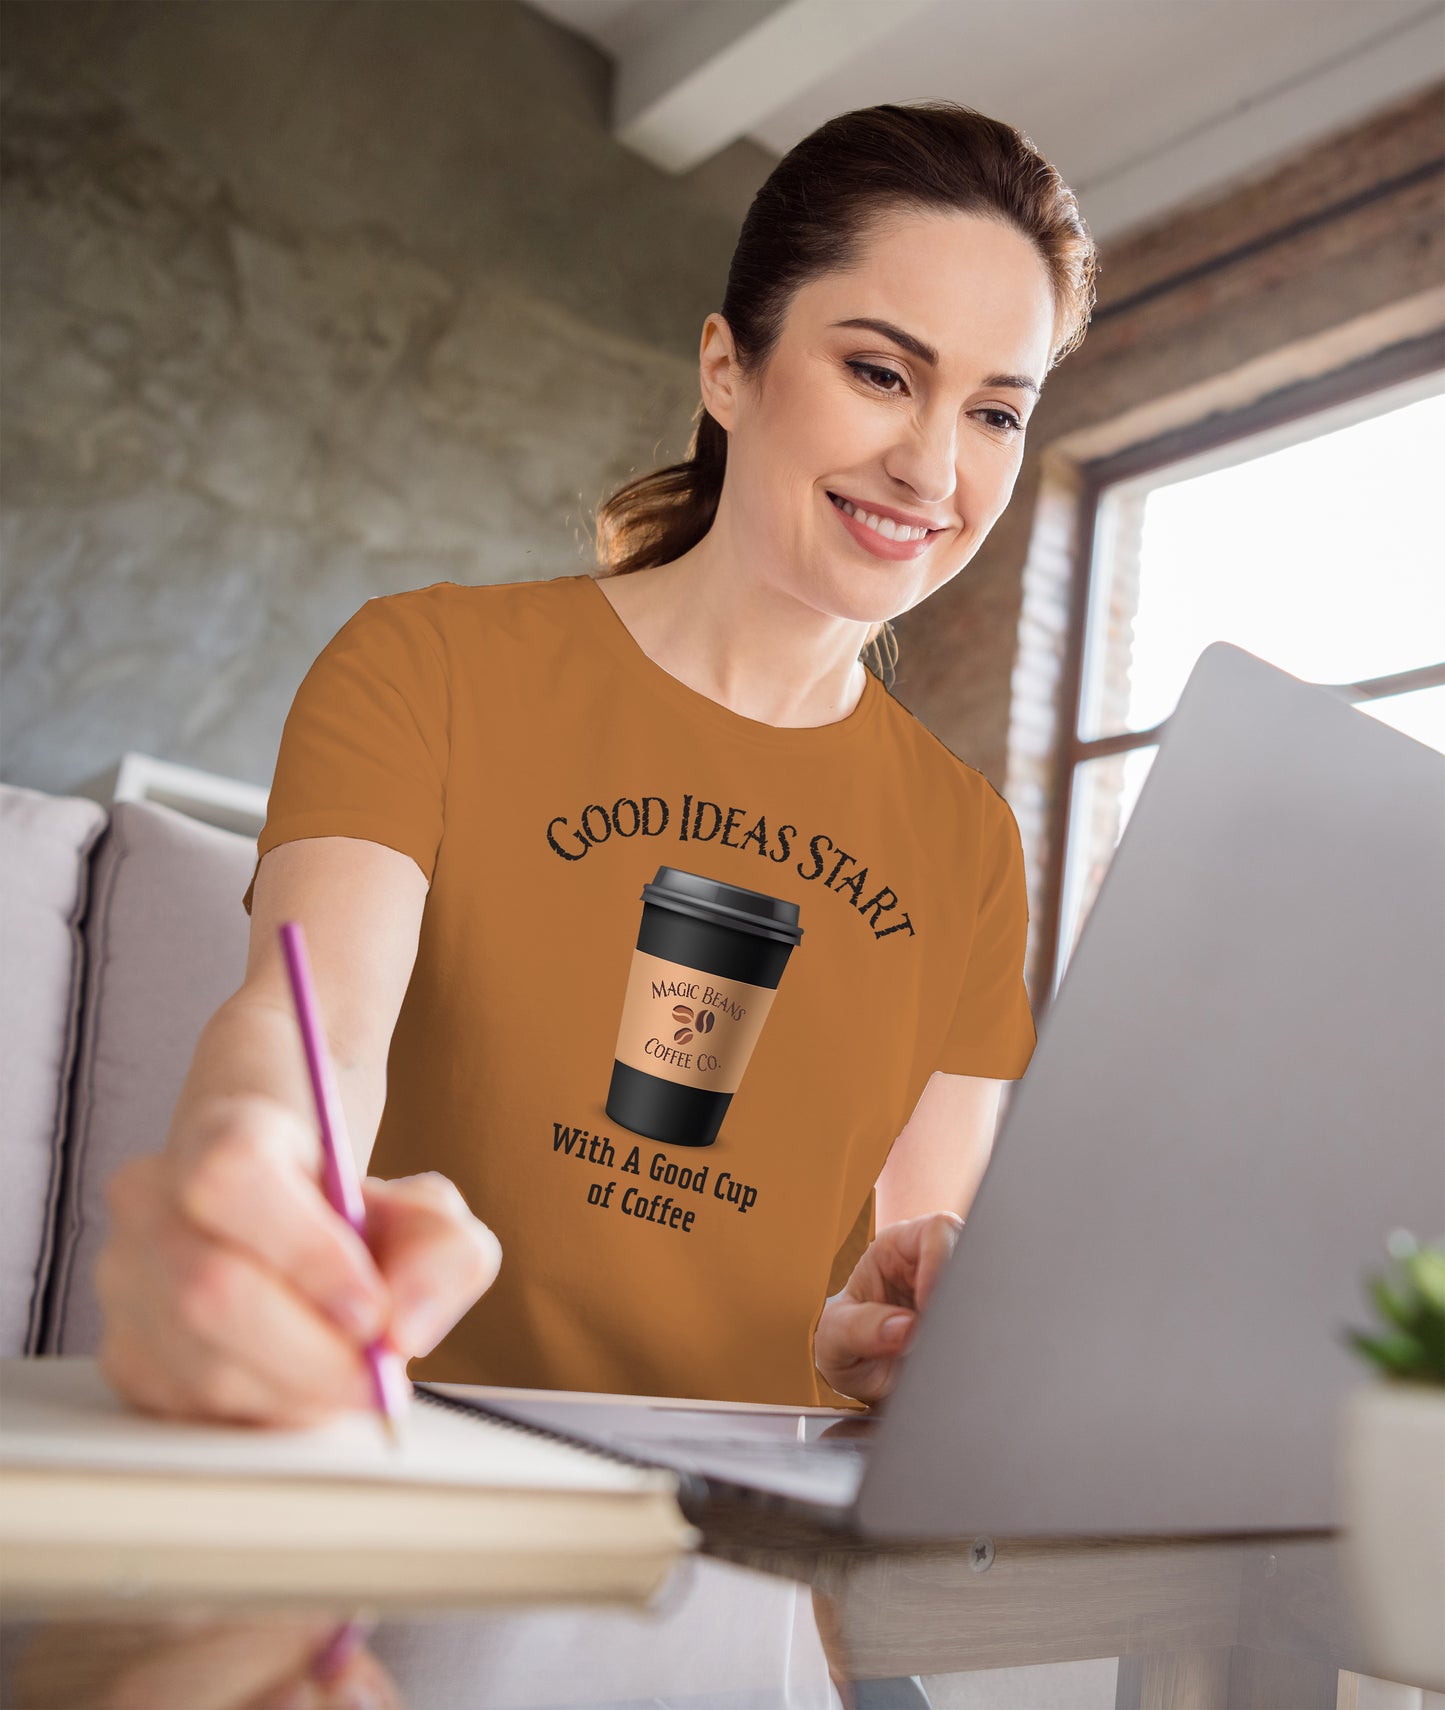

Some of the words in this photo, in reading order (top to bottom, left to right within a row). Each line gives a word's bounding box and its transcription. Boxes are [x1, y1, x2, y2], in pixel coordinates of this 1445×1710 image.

[552, 1122, 615, 1168] With
[620, 1145, 640, 1176] A
[649, 1153, 710, 1194] Good
[713, 1172, 758, 1214] Cup
[587, 1181, 617, 1209] of
[621, 1187, 696, 1233] Coffee
